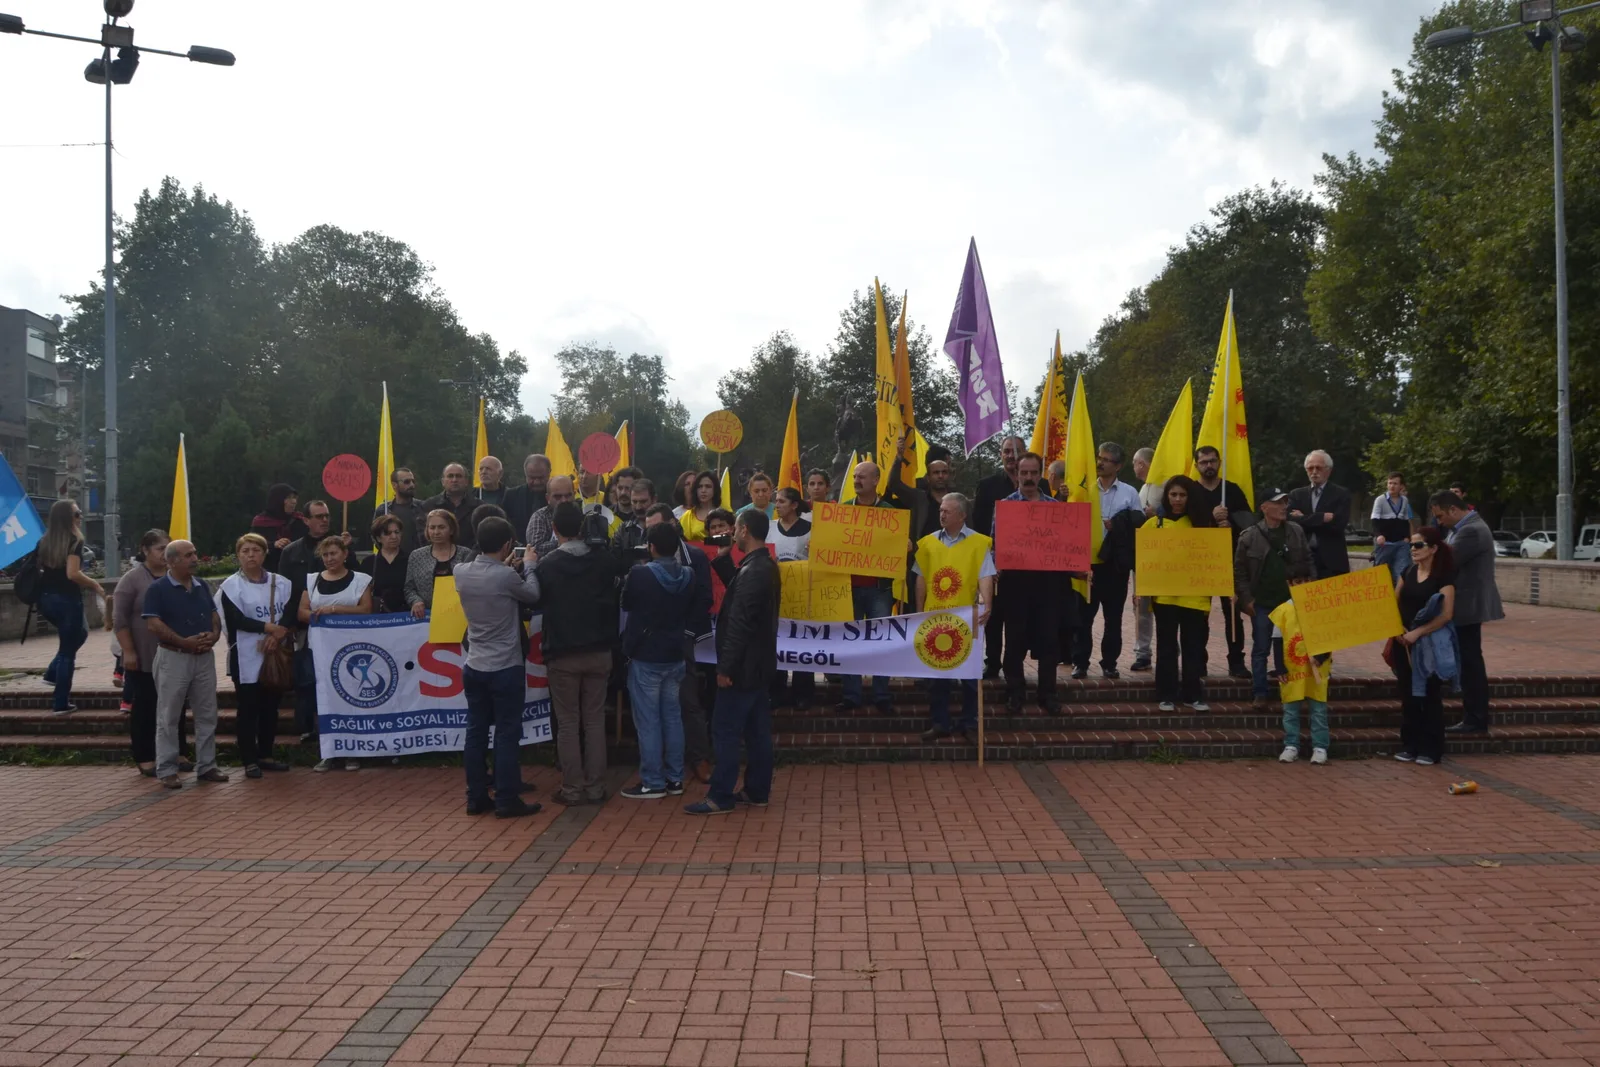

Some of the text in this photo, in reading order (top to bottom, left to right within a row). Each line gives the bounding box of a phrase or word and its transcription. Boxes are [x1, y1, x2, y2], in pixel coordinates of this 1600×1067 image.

[864, 507, 900, 533] BARIŞ
[842, 618, 910, 641] SEN
[777, 649, 841, 666] NEGÖL
[361, 689, 376, 697] SES
[330, 717, 376, 730] SAĞLIK
[378, 720, 393, 729] ve
[397, 714, 443, 728] SOSYAL
[446, 711, 468, 724] HİZ
[334, 738, 388, 751] BURSA
[393, 730, 447, 753] ŞUBESİ
